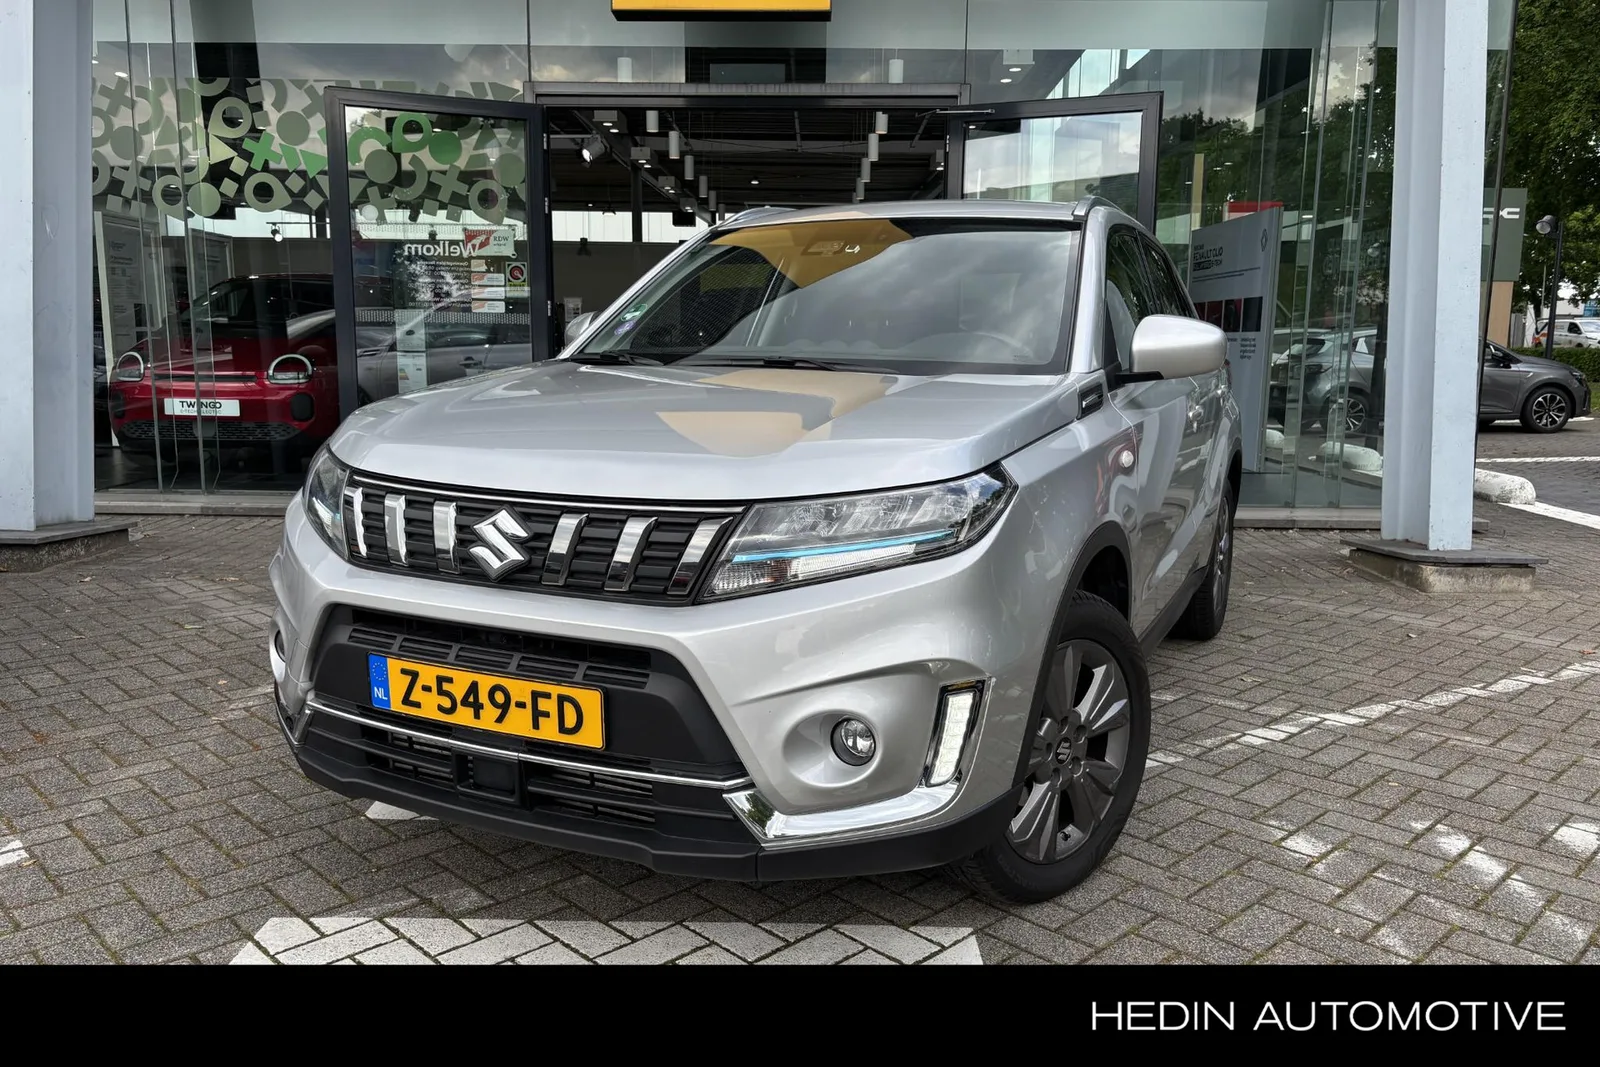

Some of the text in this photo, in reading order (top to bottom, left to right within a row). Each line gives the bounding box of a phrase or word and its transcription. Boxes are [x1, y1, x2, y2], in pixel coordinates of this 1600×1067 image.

[179, 400, 223, 409] TWNGO
[374, 686, 388, 700] NL
[399, 667, 584, 736] Z-549-FD
